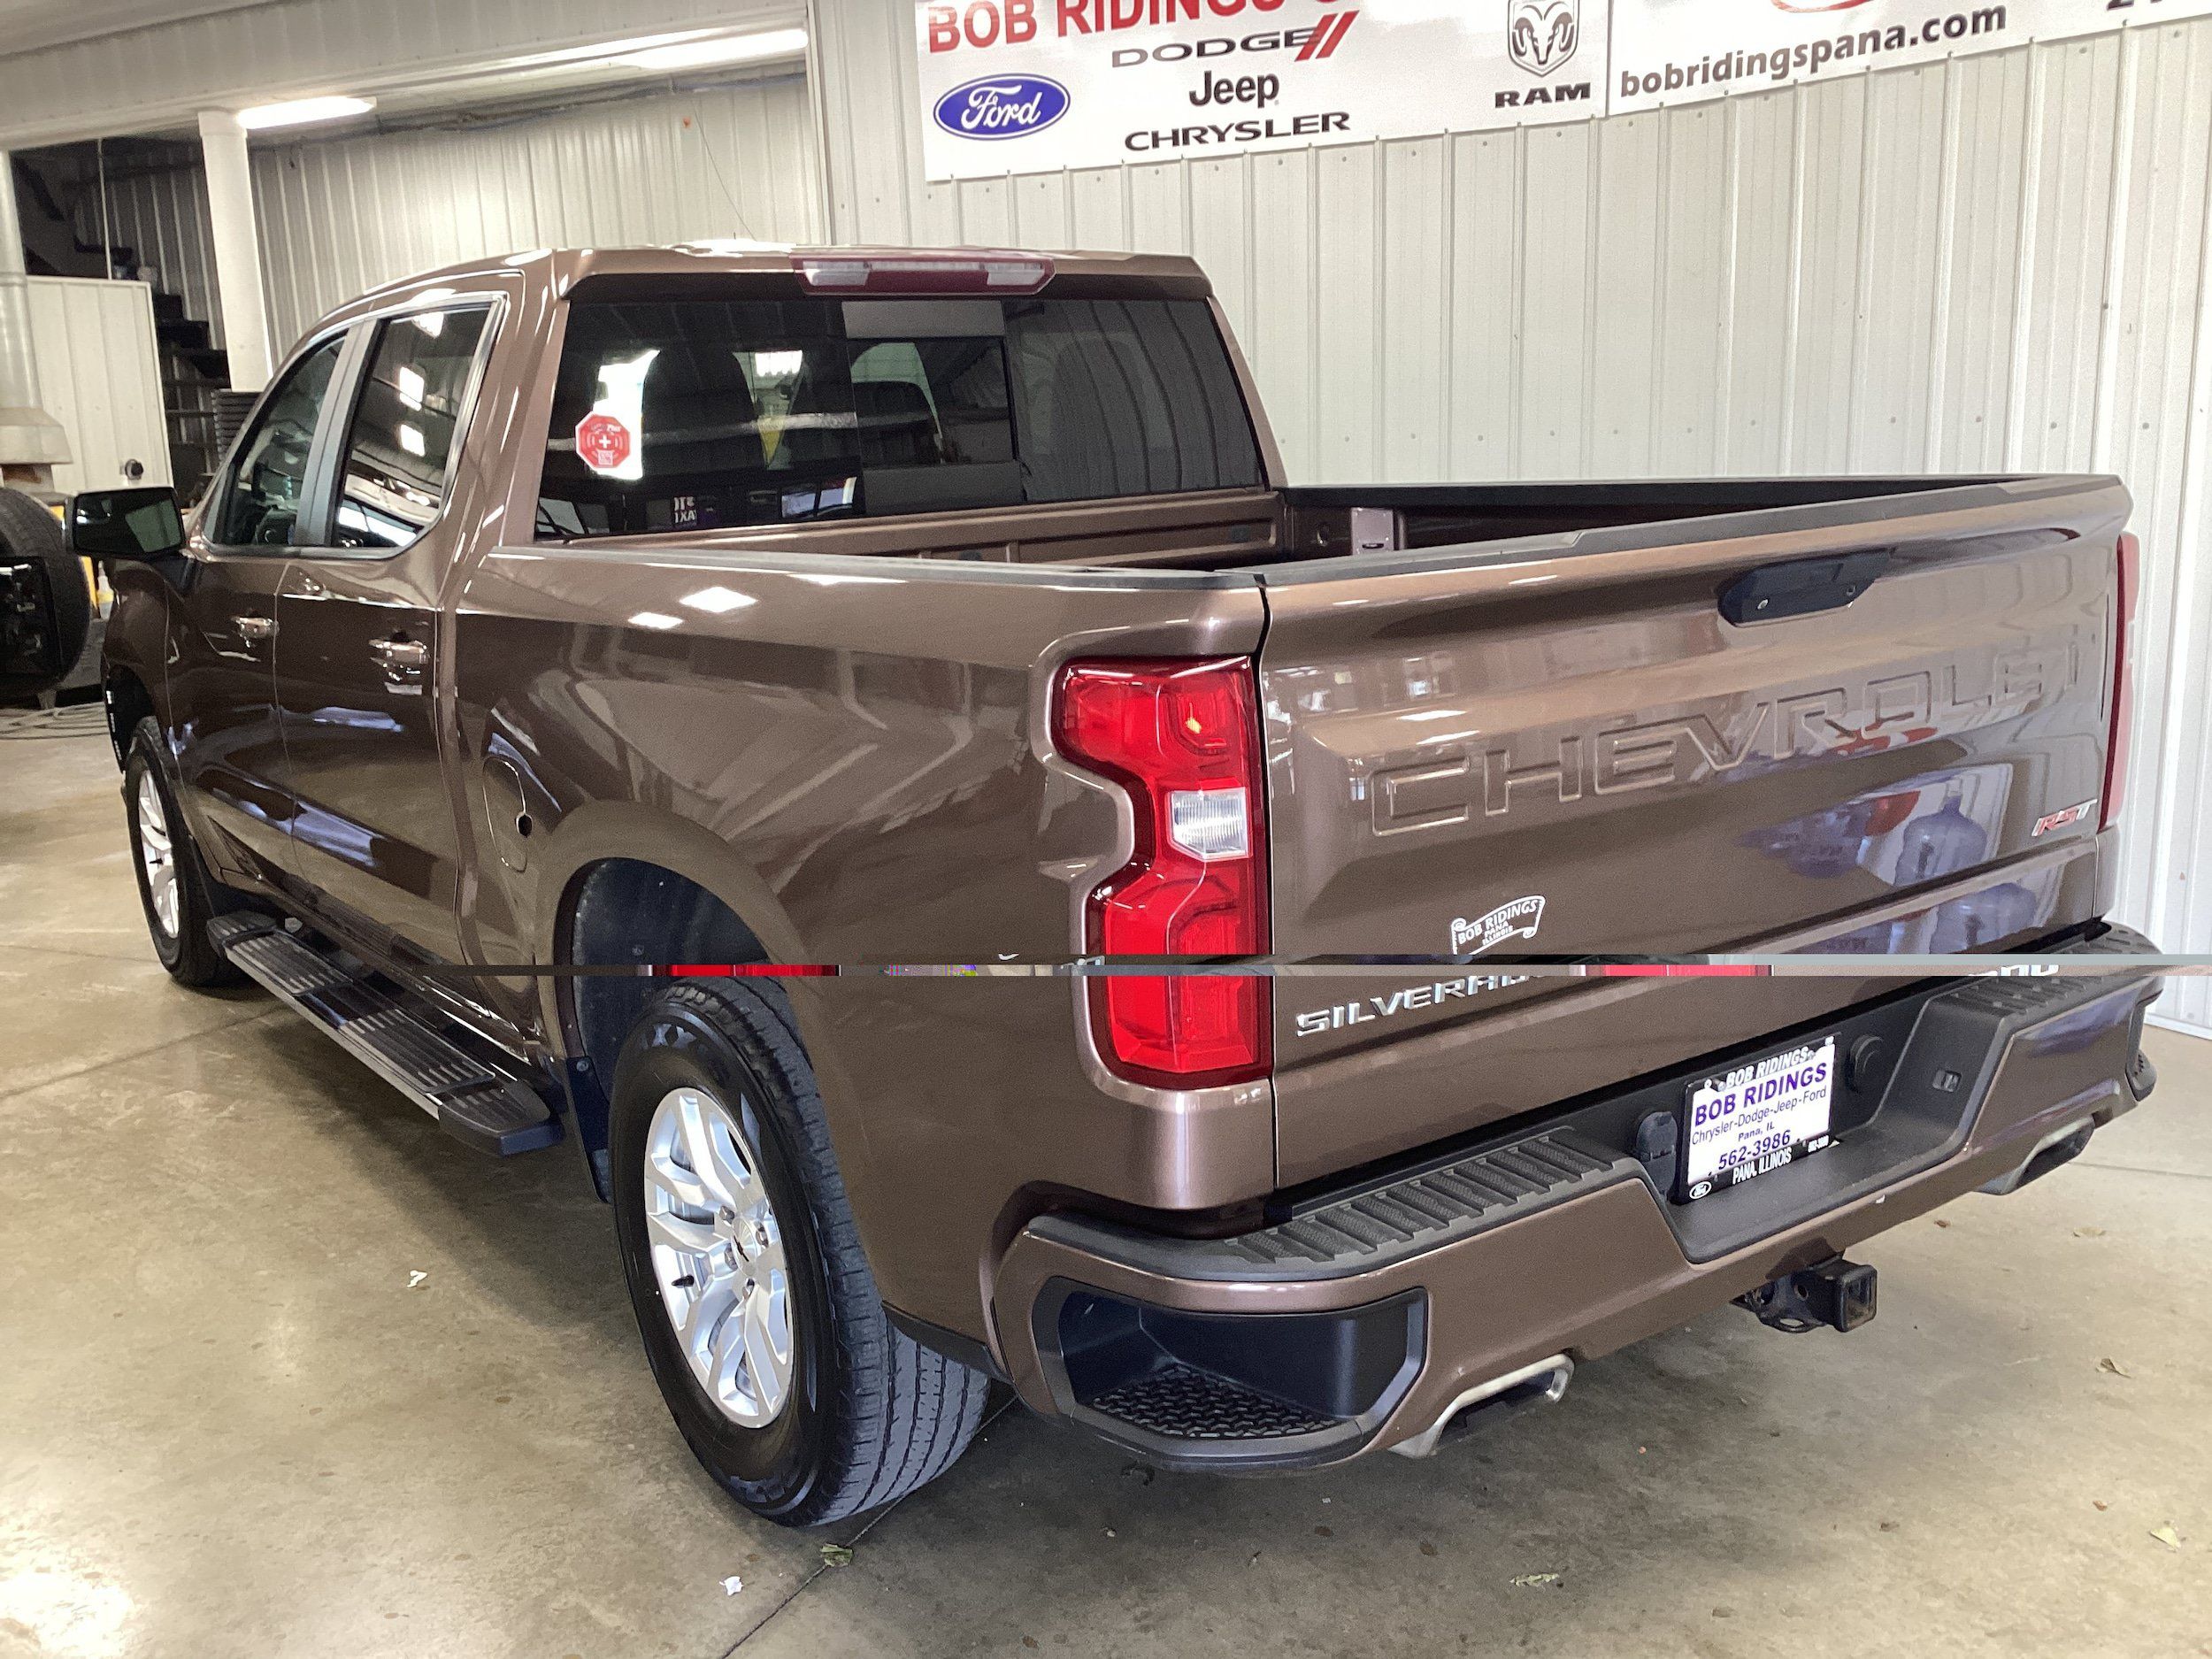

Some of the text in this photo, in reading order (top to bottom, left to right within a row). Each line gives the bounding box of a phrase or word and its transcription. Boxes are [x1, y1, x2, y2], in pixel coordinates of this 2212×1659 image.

[928, 0, 1038, 53] BOB
[1111, 26, 1321, 68] DODGE
[1620, 5, 2008, 98] bobridingspana.com
[961, 84, 1043, 130] Ford
[1188, 70, 1280, 108] Jeep
[1494, 81, 1591, 109] RAM
[1124, 111, 1351, 152] CHRYSLER
[2032, 798, 2098, 836] RST
[1457, 899, 1538, 945] BOB RIDINGS
[1724, 1046, 1809, 1090] BOB RIDINGS
[1694, 1062, 1827, 1126] BOB RIDINGS
[1692, 1085, 1826, 1146] Chrysler-Dodge-Jeep-Ford
[1766, 1121, 1775, 1132] IL
[1718, 1129, 1791, 1171] 562-3986
[1758, 1147, 1792, 1174] ILLINOIS
